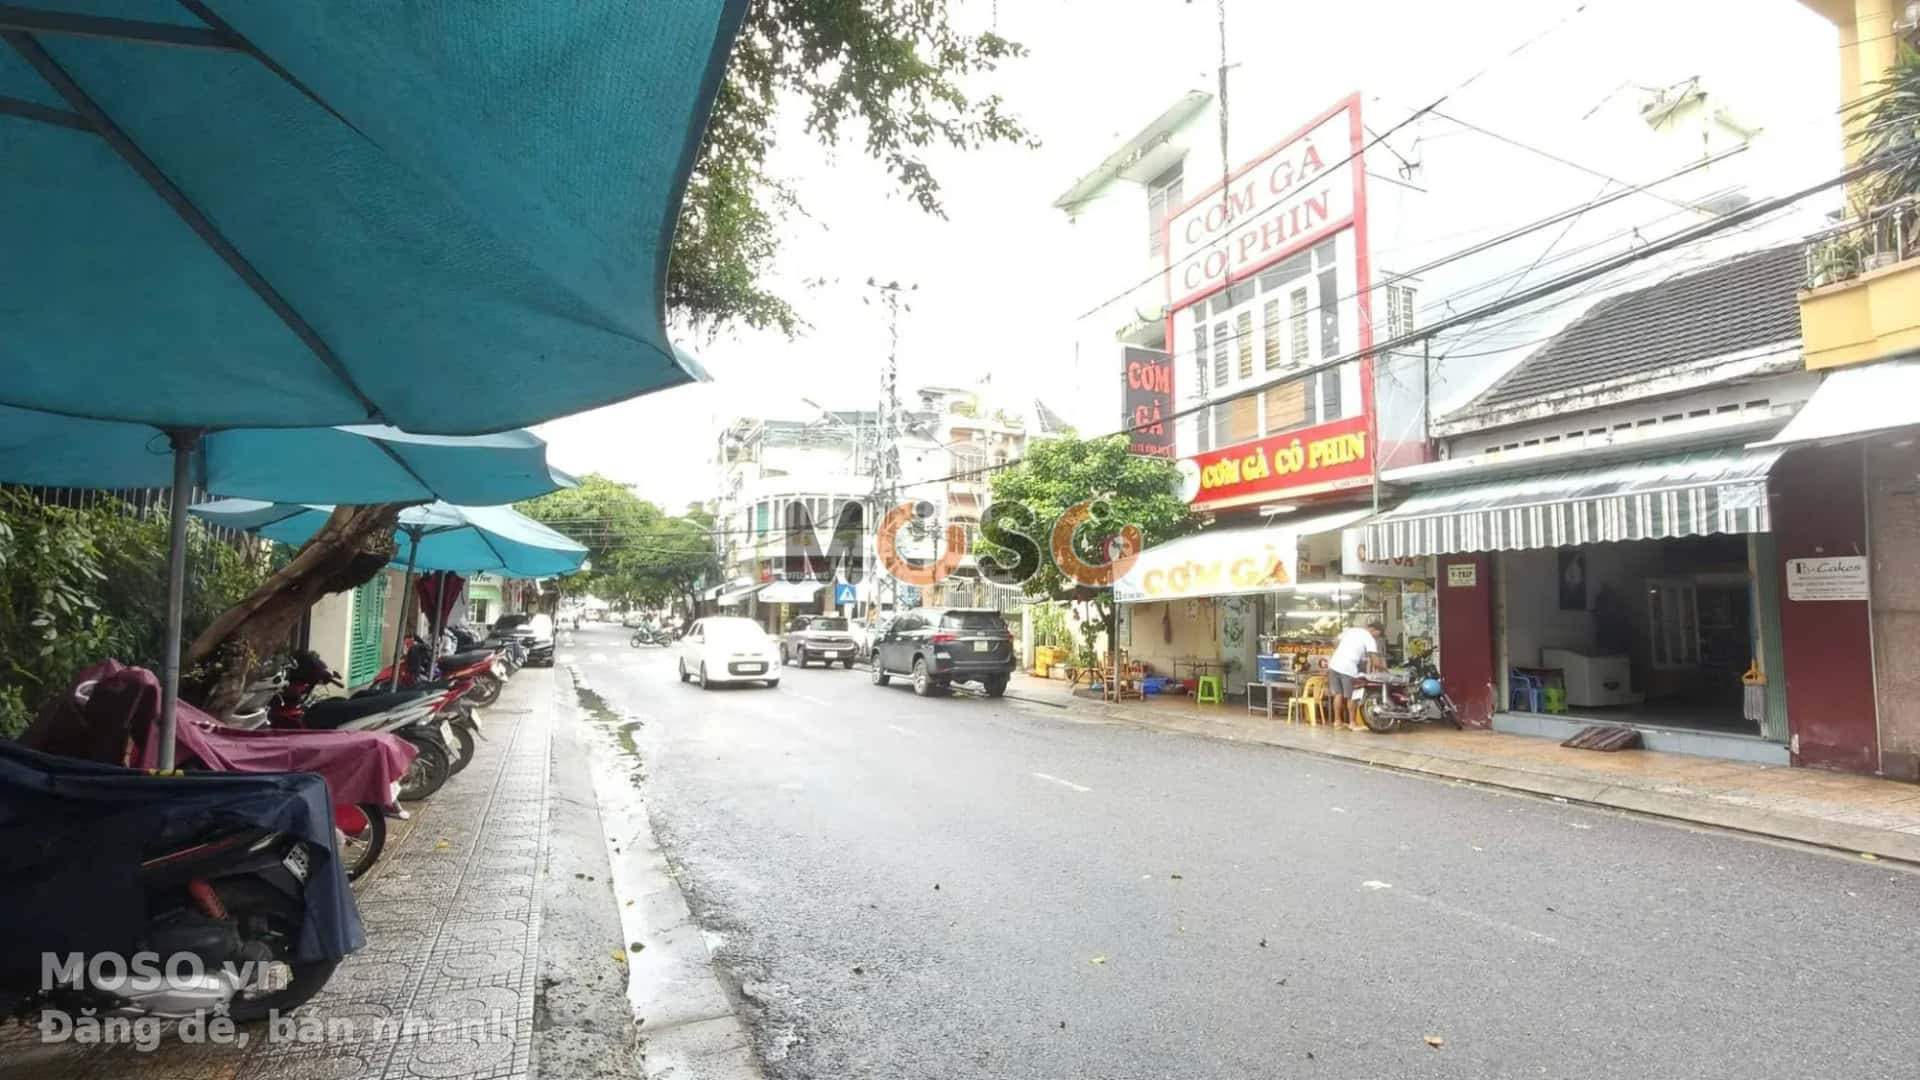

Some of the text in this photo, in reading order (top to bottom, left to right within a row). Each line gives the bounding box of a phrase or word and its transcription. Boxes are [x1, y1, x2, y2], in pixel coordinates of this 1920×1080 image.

[1270, 137, 1326, 195] GÀ
[1238, 189, 1331, 264] PHIN
[1128, 360, 1170, 394] CƠM
[1135, 399, 1165, 436] GÀ
[1202, 431, 1367, 489] CƠM GÀ CÔ PHIN
[1143, 543, 1292, 595] CƠM GÀ
